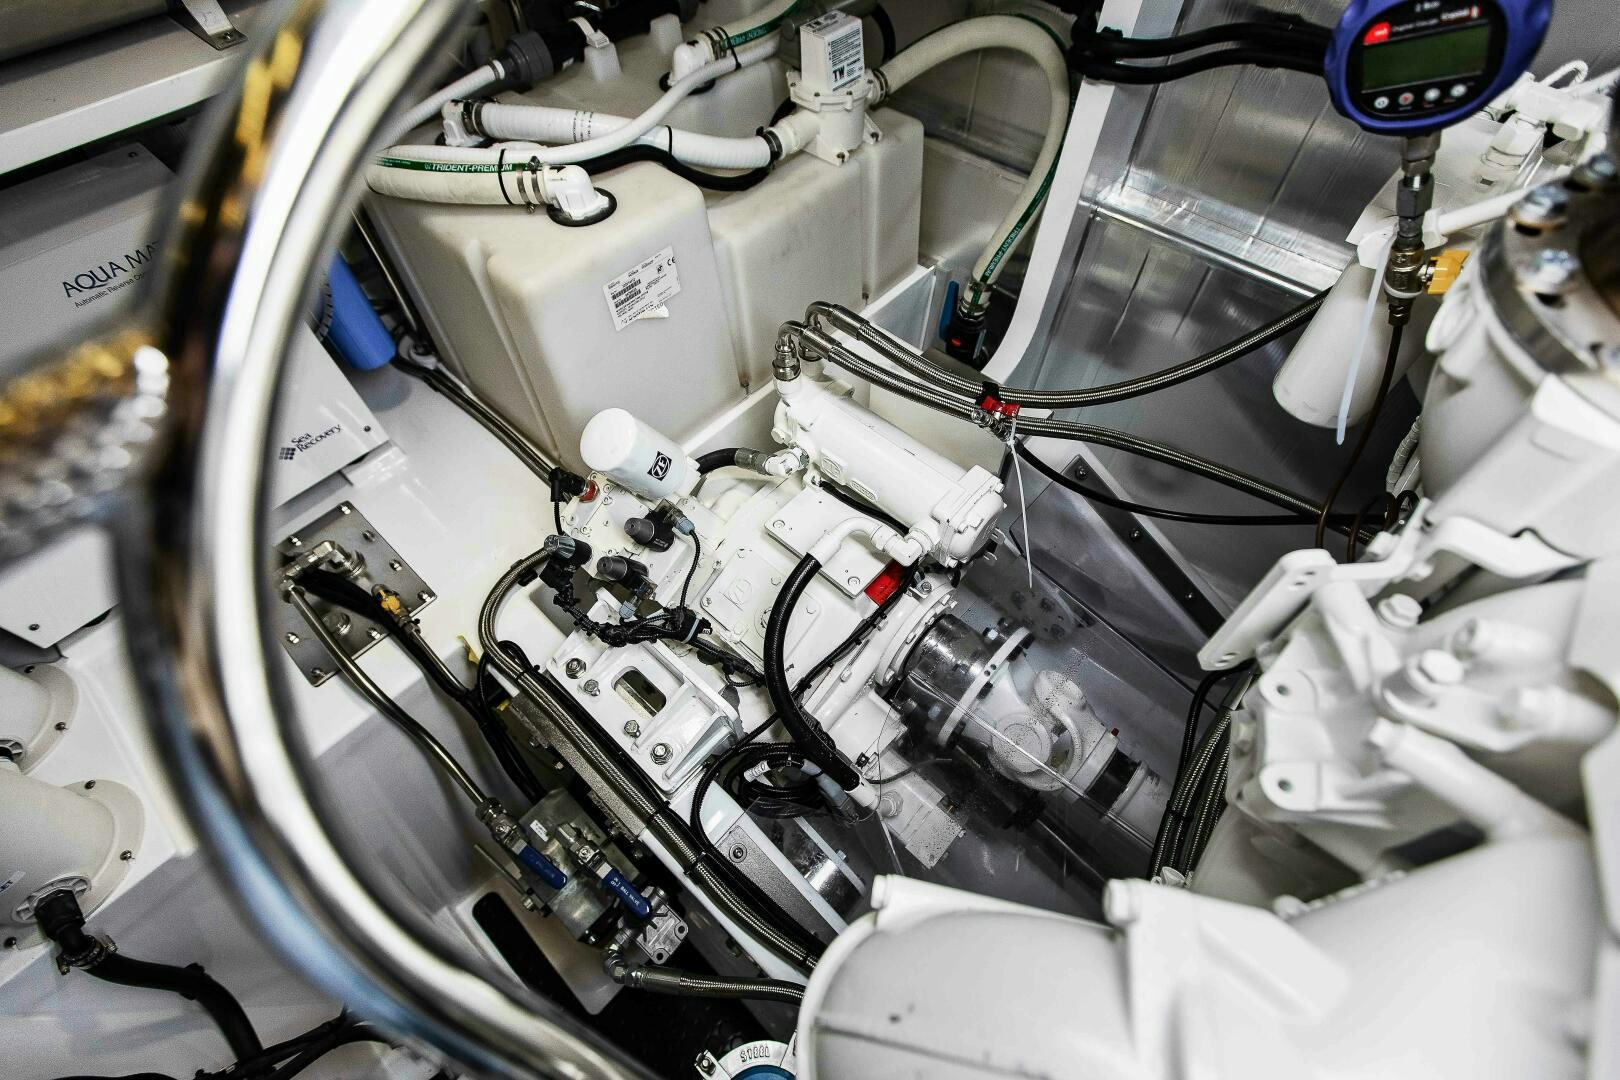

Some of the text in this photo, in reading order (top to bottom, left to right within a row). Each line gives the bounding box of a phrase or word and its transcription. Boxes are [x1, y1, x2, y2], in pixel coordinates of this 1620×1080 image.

[832, 66, 845, 82] TW
[62, 260, 128, 298] AQUA
[74, 289, 109, 309] Automatic
[291, 432, 312, 444] Sea
[295, 424, 341, 453] Recovery
[651, 455, 670, 478] ZF
